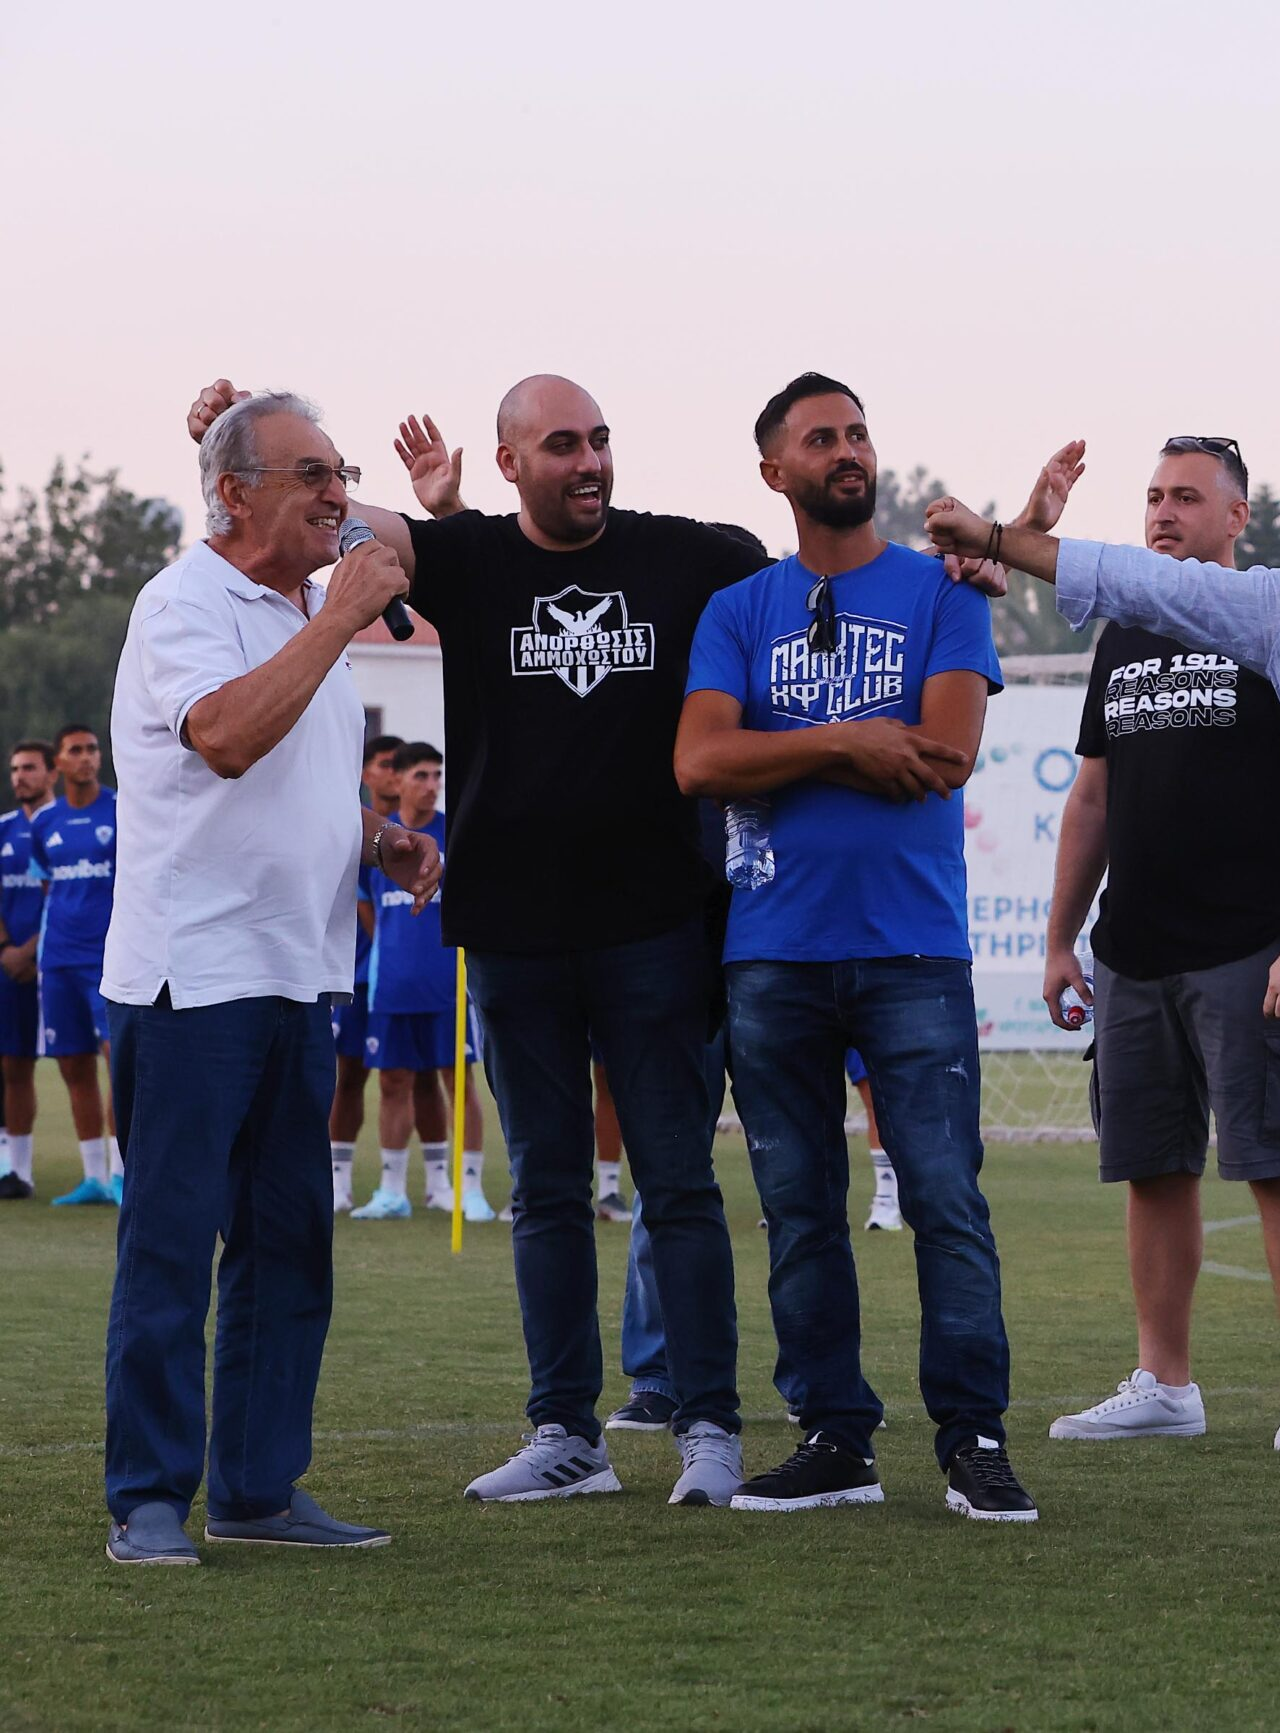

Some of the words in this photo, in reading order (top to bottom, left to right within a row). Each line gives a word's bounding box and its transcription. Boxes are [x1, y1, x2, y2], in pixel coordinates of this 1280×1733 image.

[1108, 657, 1162, 686] FOR
[1169, 653, 1239, 673] 1911
[826, 675, 903, 715] CLUB
[1105, 670, 1238, 703] REASONS
[1104, 688, 1237, 722] REASONS
[1105, 707, 1237, 740] REASONS
